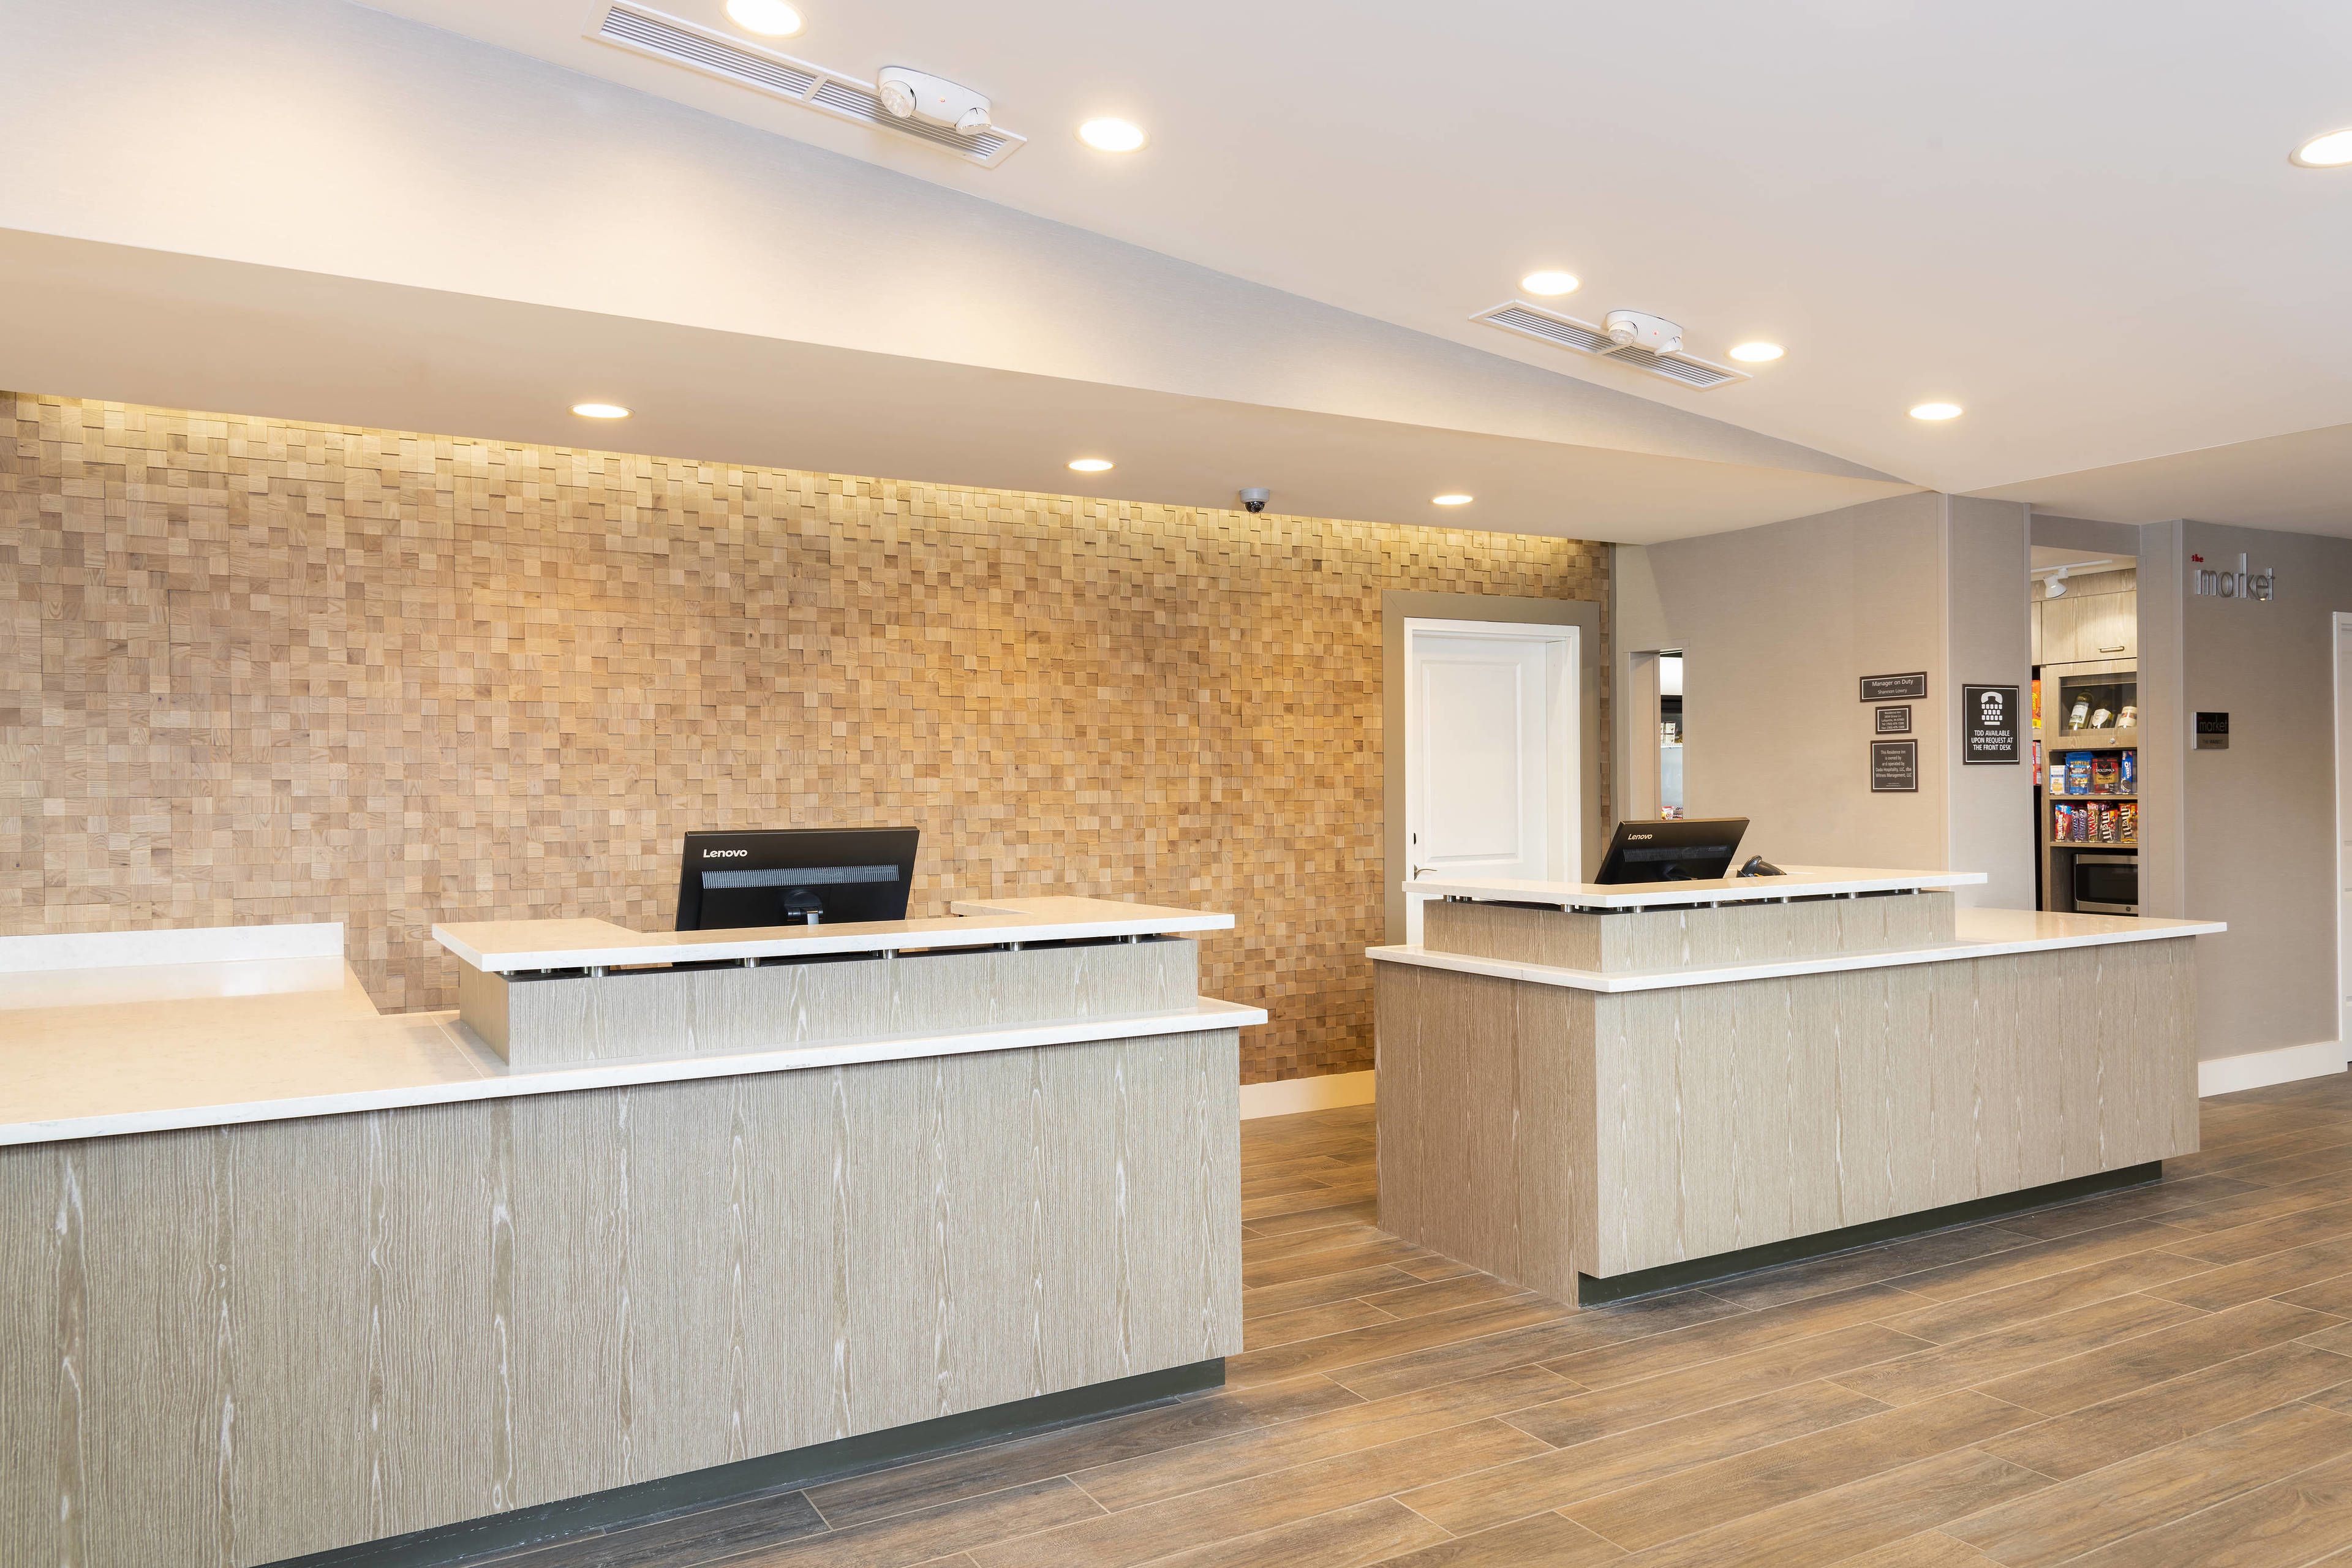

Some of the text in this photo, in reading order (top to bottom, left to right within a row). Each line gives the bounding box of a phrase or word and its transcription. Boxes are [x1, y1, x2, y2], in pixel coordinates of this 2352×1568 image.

[2192, 554, 2204, 562] the
[2195, 552, 2275, 601] market
[2199, 715, 2228, 731] market
[2087, 812, 2098, 840] TWIX
[703, 849, 748, 858] Lenovo
